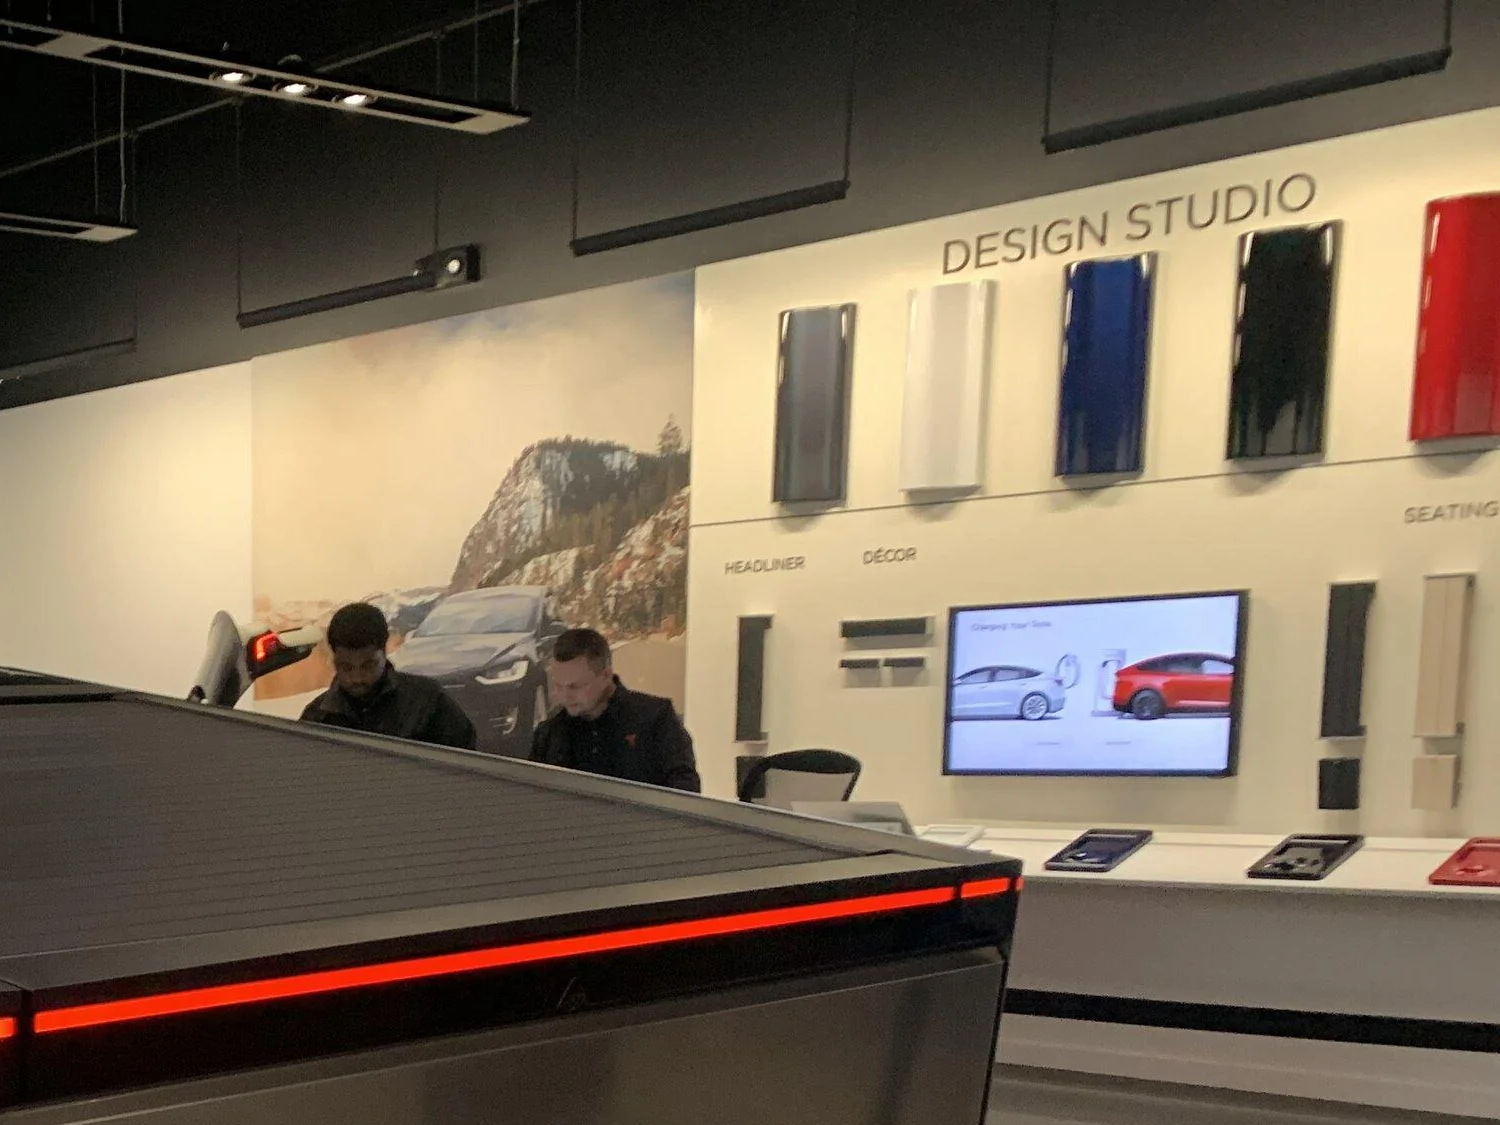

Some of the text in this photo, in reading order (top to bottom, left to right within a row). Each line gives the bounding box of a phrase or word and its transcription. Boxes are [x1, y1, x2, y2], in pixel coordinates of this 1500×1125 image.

[943, 172, 1317, 275] DESIGN STUDIO
[1403, 500, 1499, 524] SEATING
[724, 555, 806, 575] HEADLINER
[862, 546, 918, 565] DÉCOR
